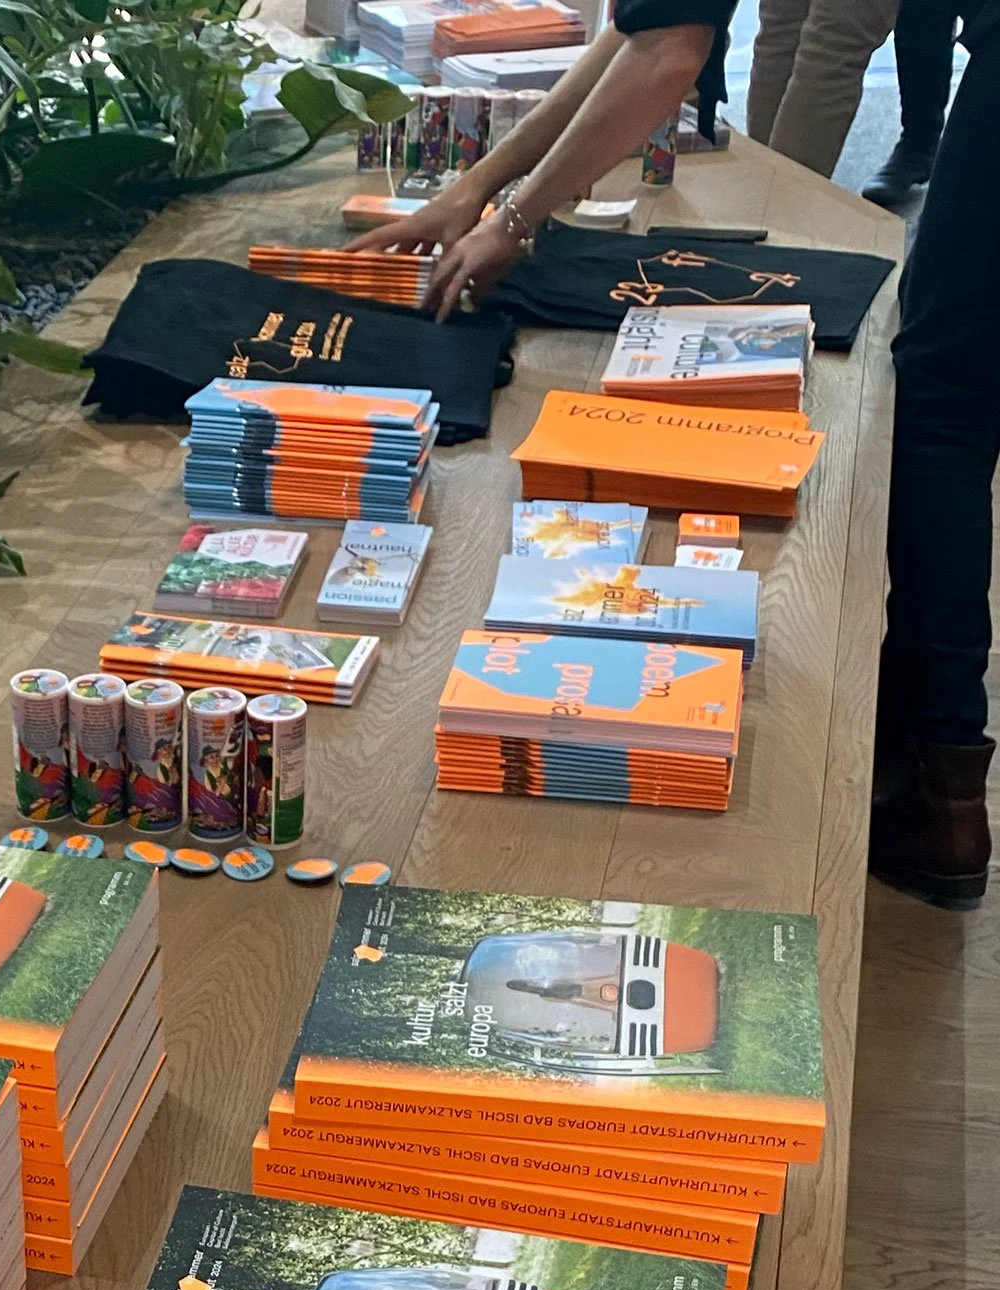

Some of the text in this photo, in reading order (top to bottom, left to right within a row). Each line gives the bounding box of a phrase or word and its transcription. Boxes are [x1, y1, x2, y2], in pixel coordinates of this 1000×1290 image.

[567, 403, 817, 446] Programm 2024
[324, 591, 397, 604] passion
[482, 634, 531, 676] plot
[639, 642, 677, 699] poem
[551, 661, 595, 717] prosa
[441, 980, 469, 1016] salzt
[403, 999, 438, 1046] kultur
[467, 1004, 498, 1058] europa
[309, 1095, 786, 1147] KULTURHAUPTSTADT EUROPAS BAD ISCHL SALZKAMMERGUT 2024
[26, 1174, 56, 1187] 2024
[283, 1127, 747, 1196] KULTURHAUPTSTADT EUROPAS BAD ISCHL SALZKAMMERGUT 2024
[266, 1163, 720, 1243] KULTURHAUPTSTADT EUROPAS BAD ISCHL SALZKAMMERGUT 2024
[211, 1260, 224, 1278] 2024
